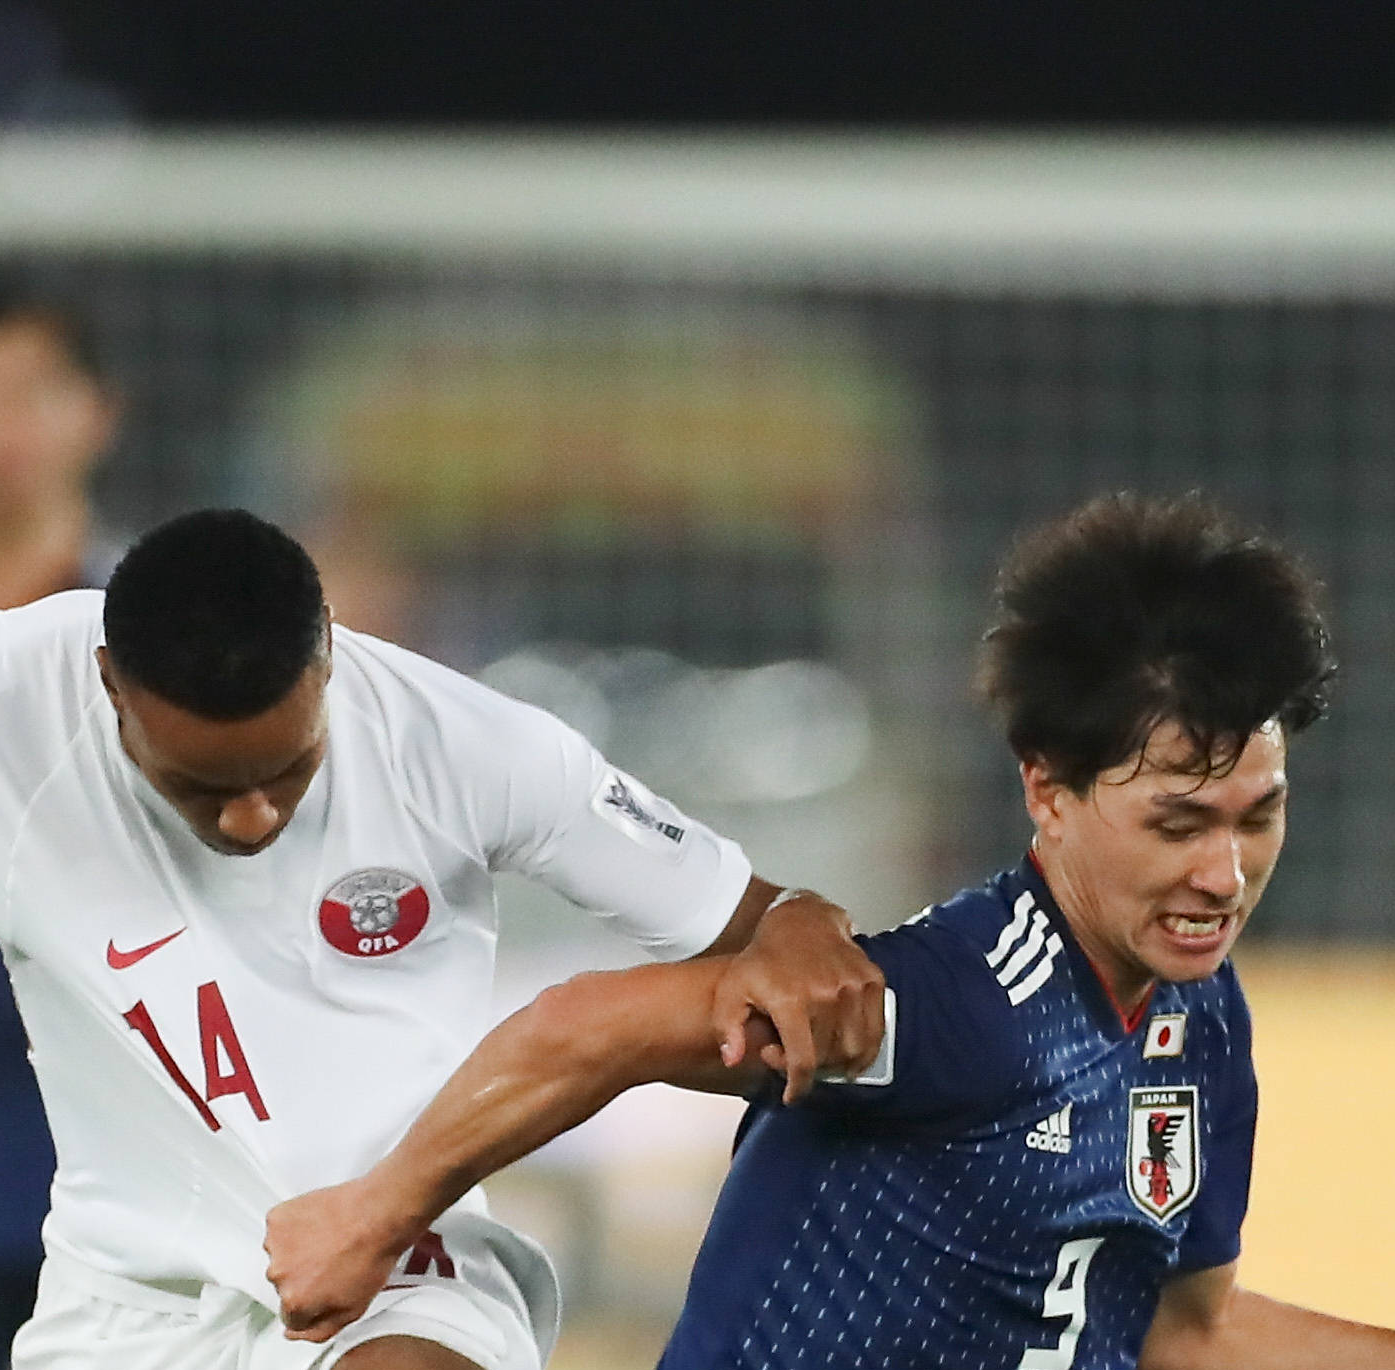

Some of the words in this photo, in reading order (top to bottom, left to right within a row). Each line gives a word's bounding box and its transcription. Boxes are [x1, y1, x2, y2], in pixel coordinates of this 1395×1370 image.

[358, 935, 399, 953] QFA
[122, 980, 271, 1132] 14
[1141, 1093, 1178, 1104] JAPAN
[1025, 1131, 1072, 1154] adidas
